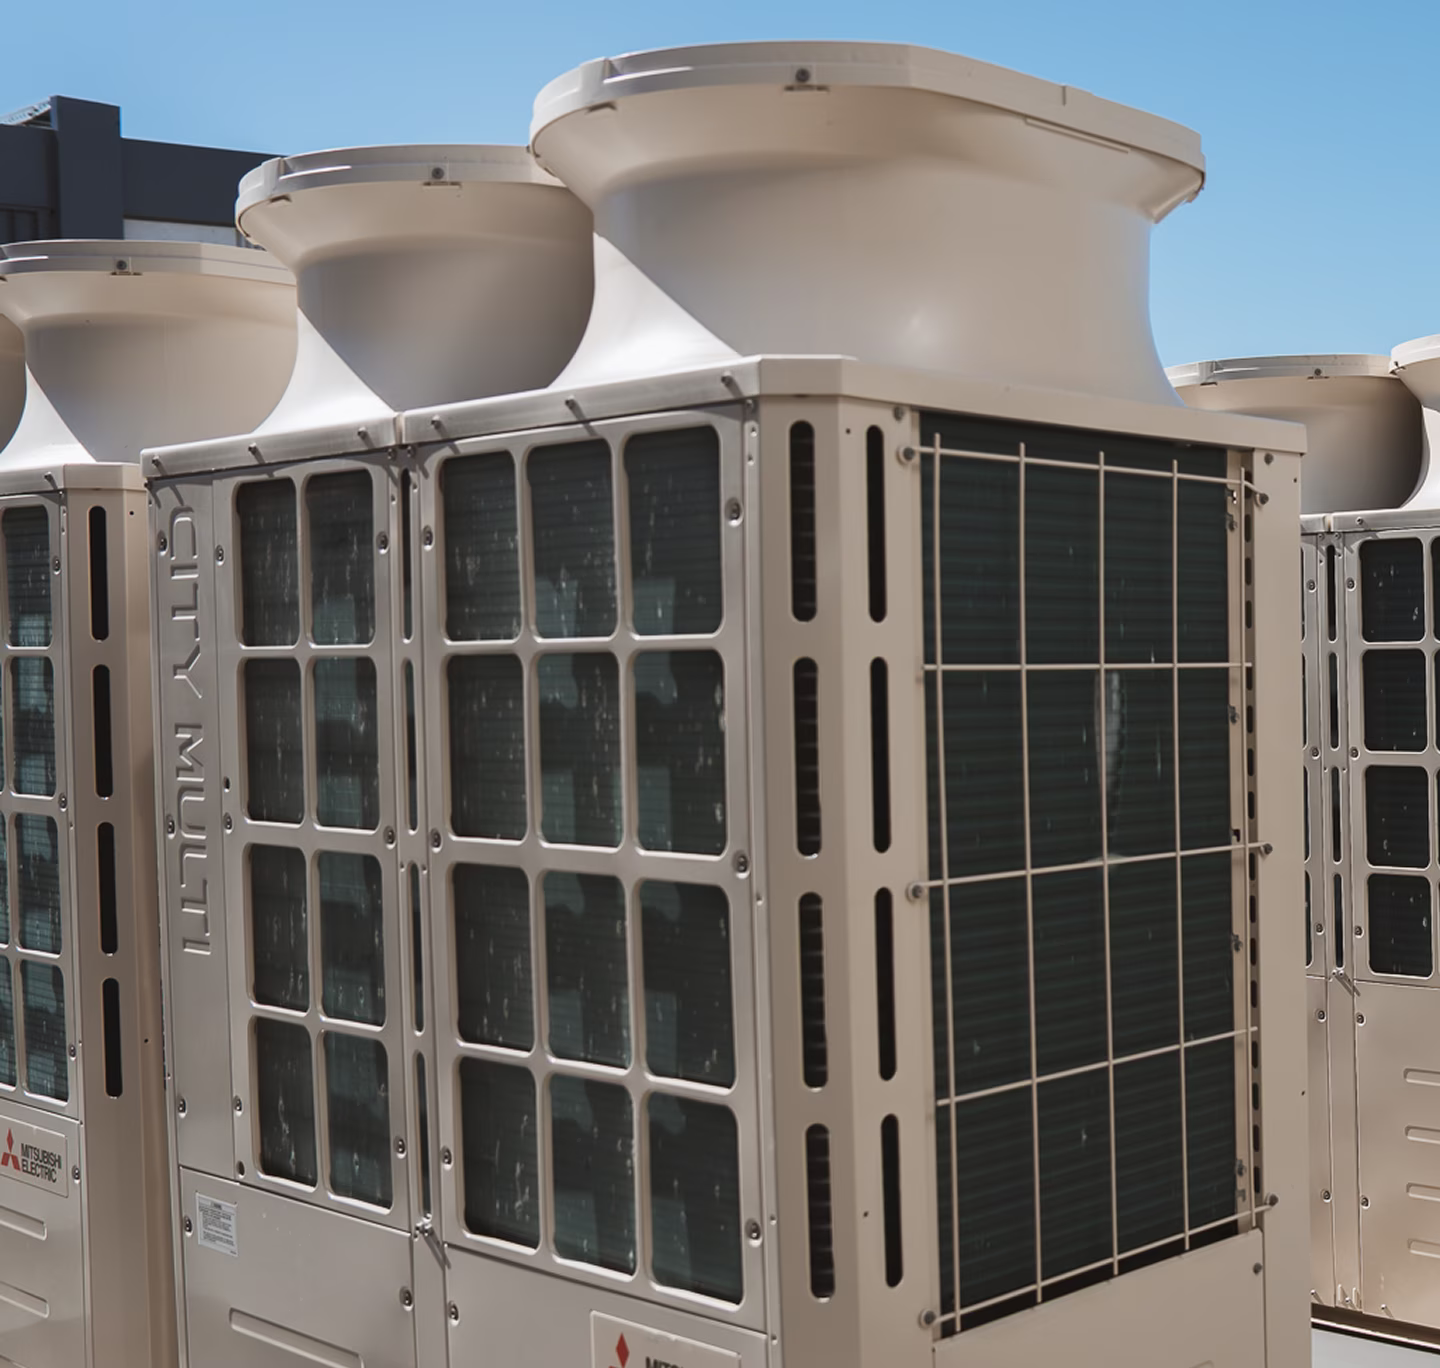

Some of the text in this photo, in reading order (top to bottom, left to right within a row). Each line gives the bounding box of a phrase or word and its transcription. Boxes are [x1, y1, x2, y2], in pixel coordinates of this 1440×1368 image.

[170, 506, 211, 956] CITY MULTI
[21, 1142, 62, 1169] MITSUBISHI
[22, 1158, 57, 1183] ELECTRIC
